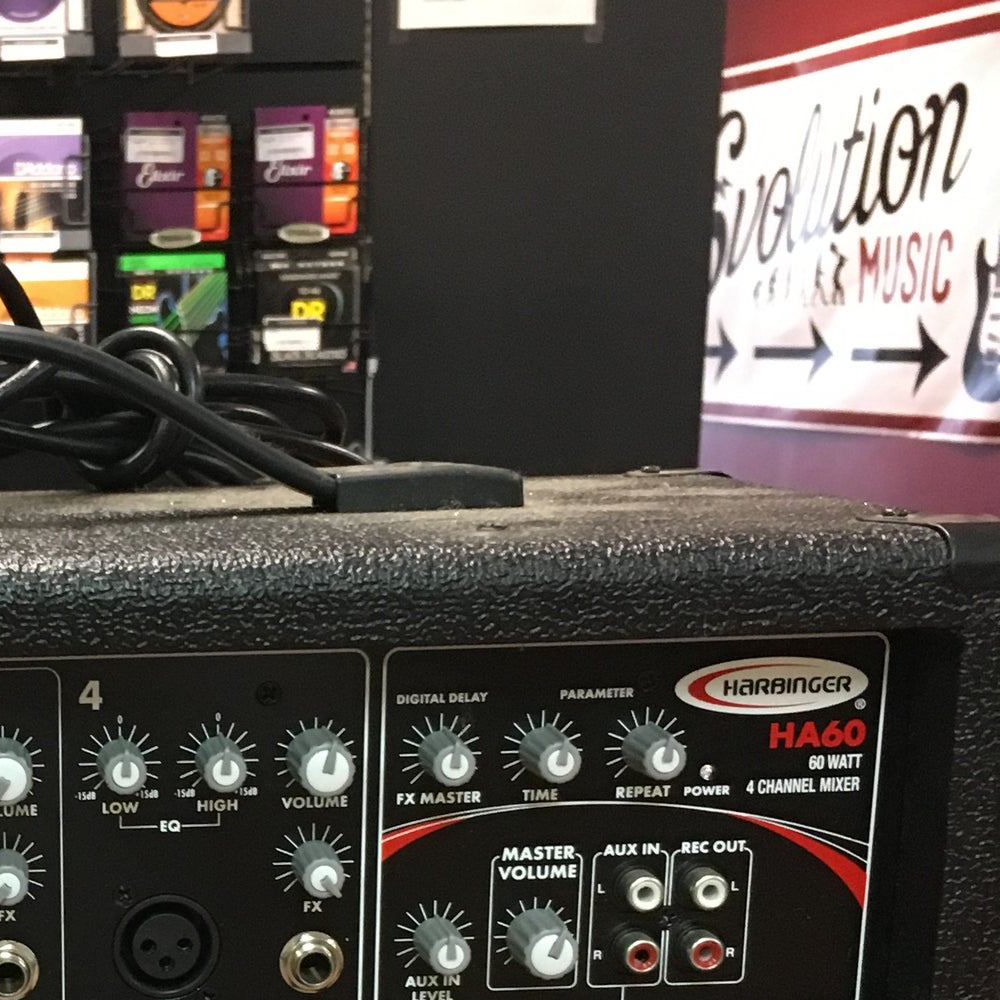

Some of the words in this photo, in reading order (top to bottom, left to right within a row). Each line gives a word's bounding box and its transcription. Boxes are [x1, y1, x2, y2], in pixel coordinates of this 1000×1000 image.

[857, 229, 954, 304] MUSIC
[722, 675, 851, 697] HARBINGER
[78, 679, 103, 711] 4
[396, 693, 446, 705] DIGITAL
[449, 691, 489, 704] DELAY
[559, 687, 634, 700] PARAMETER
[769, 718, 867, 749] HA60
[808, 754, 825, 770] 60
[828, 753, 863, 769] WATT
[615, 785, 671, 799] REPEAT
[683, 784, 730, 797] POWER
[745, 778, 755, 794] 4
[757, 777, 816, 795] CHANNEL
[819, 776, 861, 793] MIXER
[281, 795, 348, 809] VOLUME
[396, 793, 416, 806] FX
[420, 791, 482, 805] MASTER
[522, 788, 559, 802] TIME
[101, 801, 139, 815] LOW
[197, 799, 238, 813] HIGH
[159, 819, 181, 833] EQ
[501, 845, 575, 862] MASTER
[603, 843, 639, 856] AUX
[643, 842, 660, 855] IN
[681, 841, 712, 854] REC
[715, 839, 746, 853] OUT
[498, 865, 577, 881] VOLUME
[597, 884, 605, 895] L
[731, 881, 739, 892] L
[303, 900, 323, 913] FX
[593, 949, 602, 960] R
[726, 947, 735, 958] R
[405, 975, 439, 988] AUX
[442, 974, 461, 987] IN
